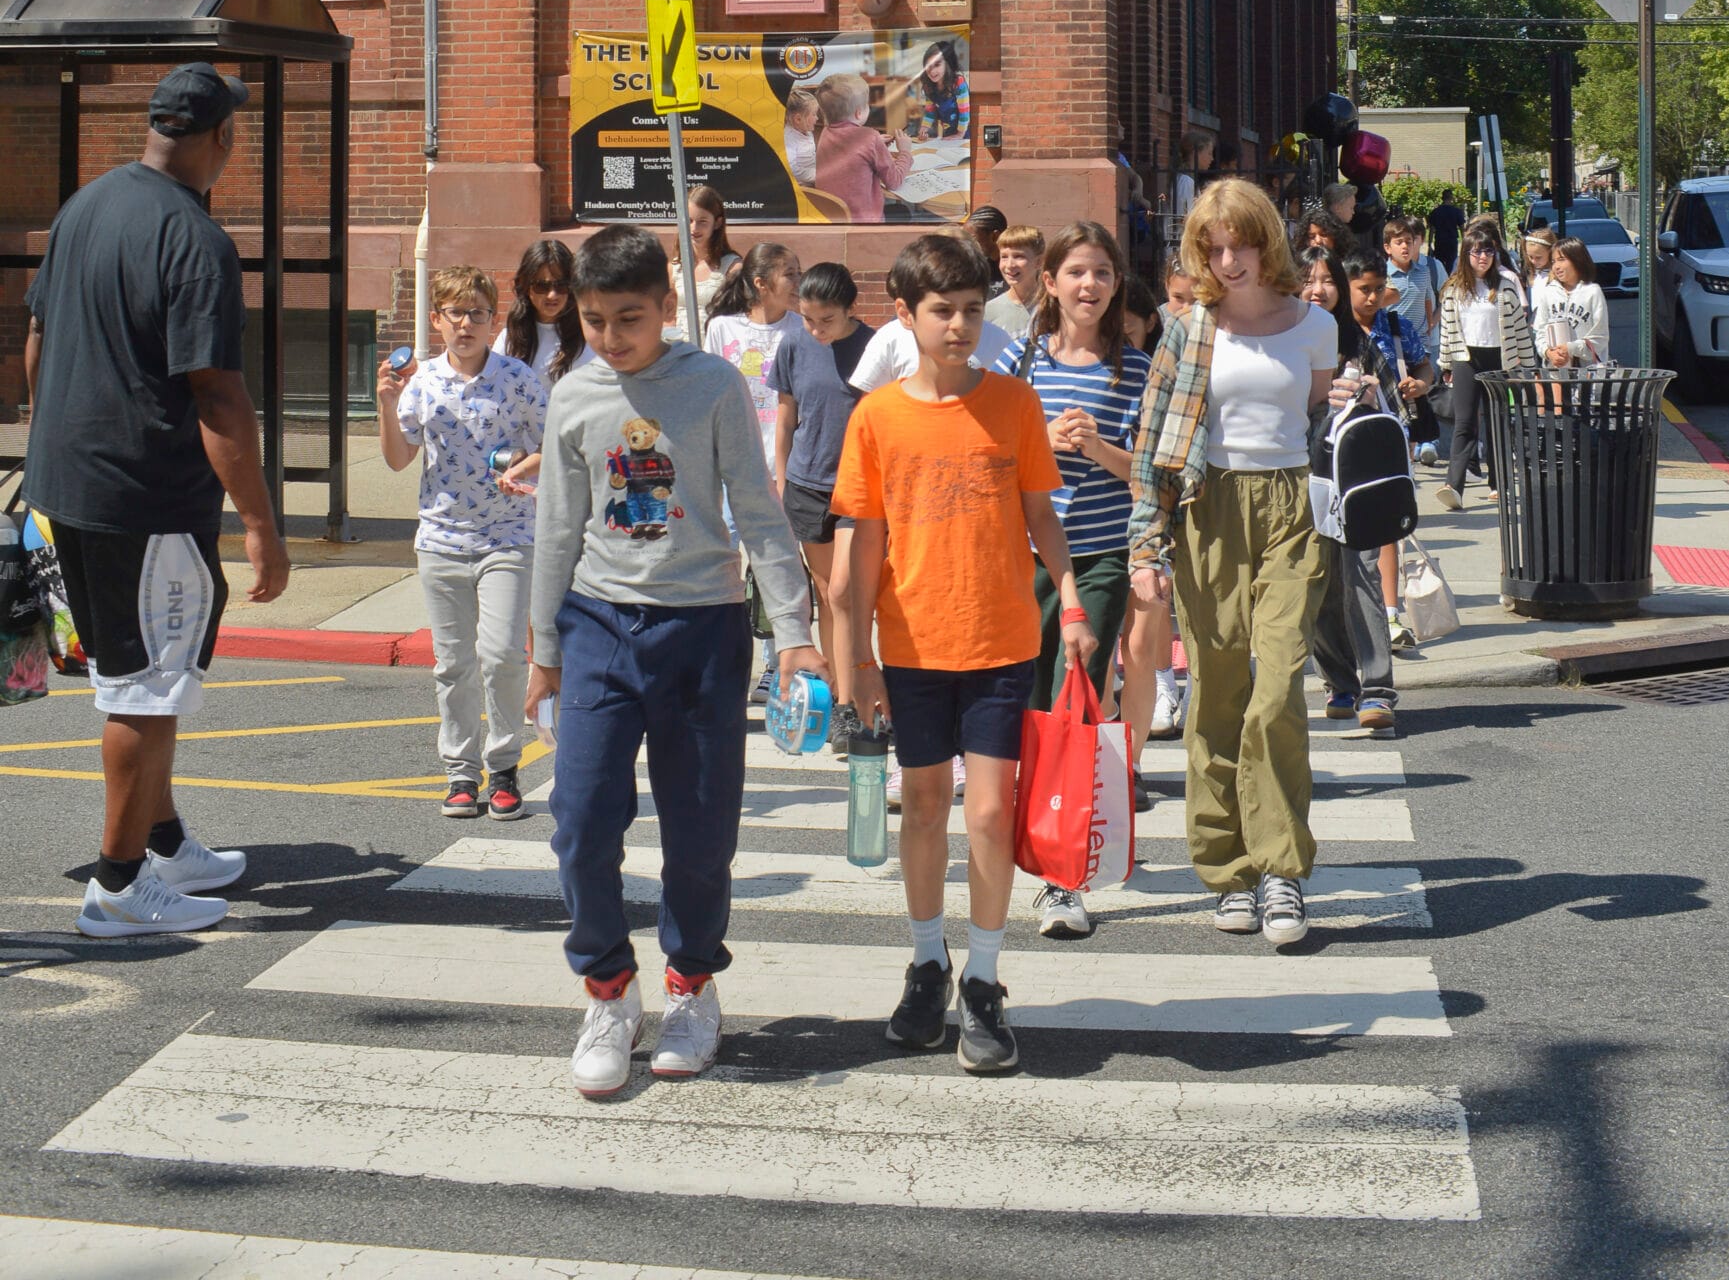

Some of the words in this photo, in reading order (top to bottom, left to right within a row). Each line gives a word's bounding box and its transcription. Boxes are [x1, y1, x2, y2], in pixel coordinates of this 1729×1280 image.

[582, 44, 631, 62] THE
[632, 116, 662, 125] Come
[683, 116, 699, 125] Us:
[584, 201, 615, 209] Hudson
[616, 201, 650, 210] County's
[651, 201, 671, 210] Only
[723, 201, 749, 209] School
[751, 201, 764, 209] for
[166, 580, 184, 641] AND1
